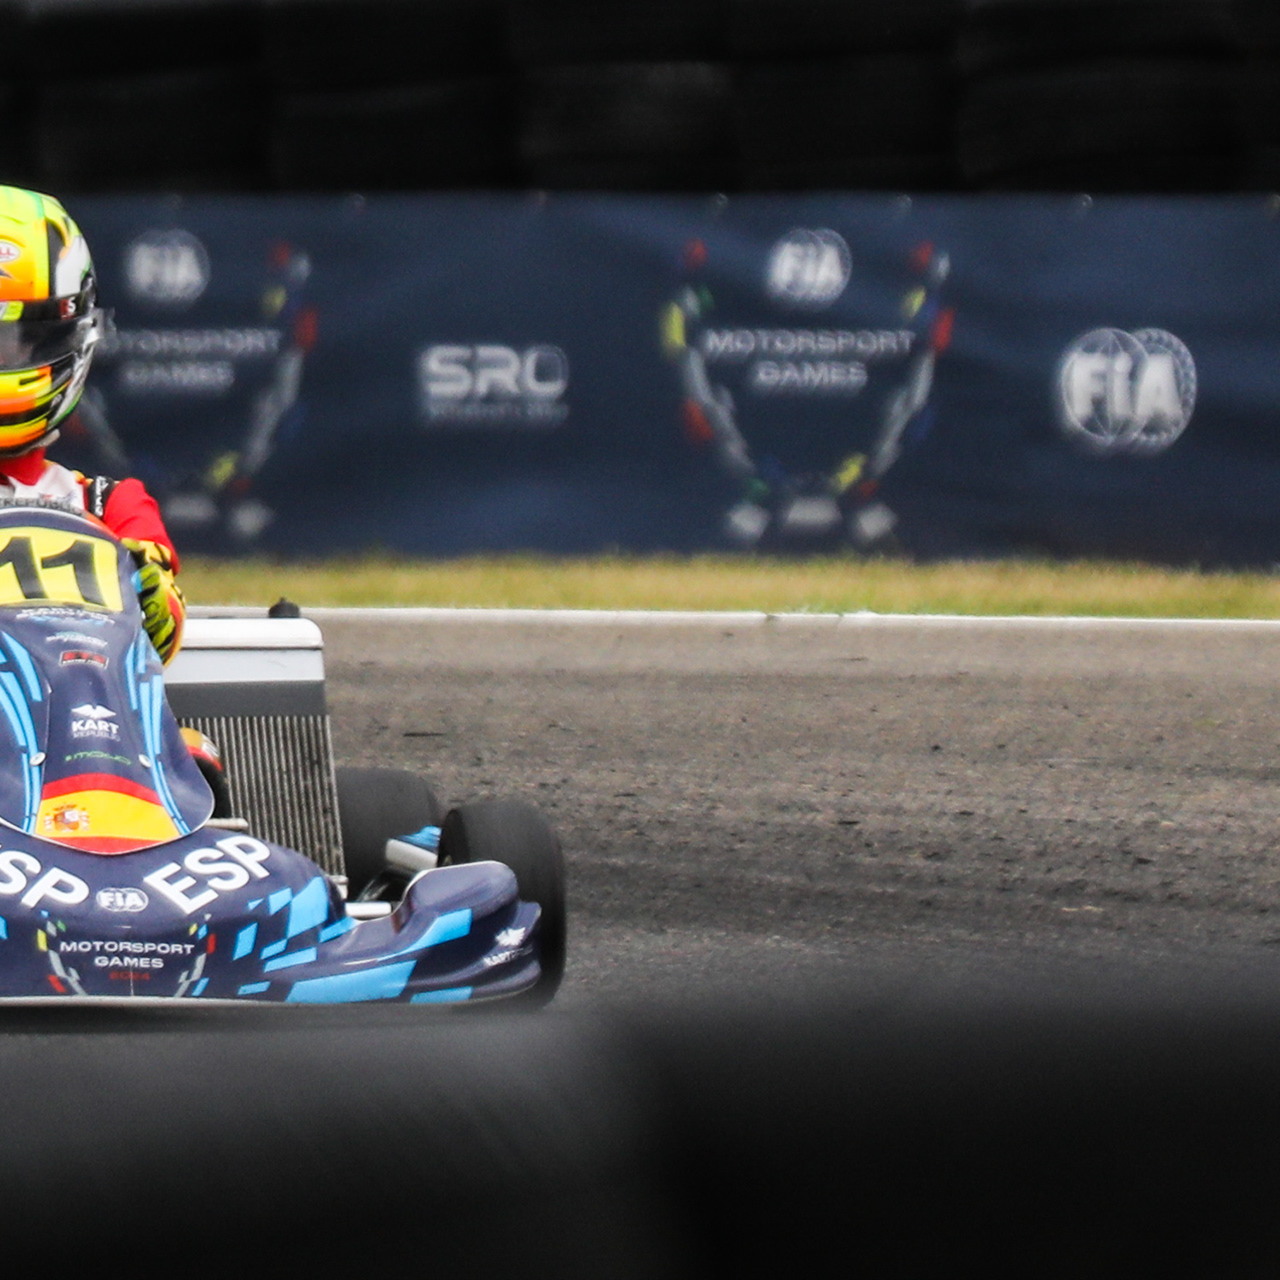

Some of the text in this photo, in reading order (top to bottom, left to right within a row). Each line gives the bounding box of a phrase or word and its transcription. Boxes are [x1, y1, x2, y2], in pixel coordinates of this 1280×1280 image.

[703, 329, 916, 356] MOTORSPORT
[420, 345, 569, 399] SRC
[752, 361, 869, 389] GAMES
[71, 719, 119, 734] KART
[143, 835, 271, 915] ESP
[60, 941, 196, 955] MOTORSPORT
[94, 956, 165, 969] GAMES
